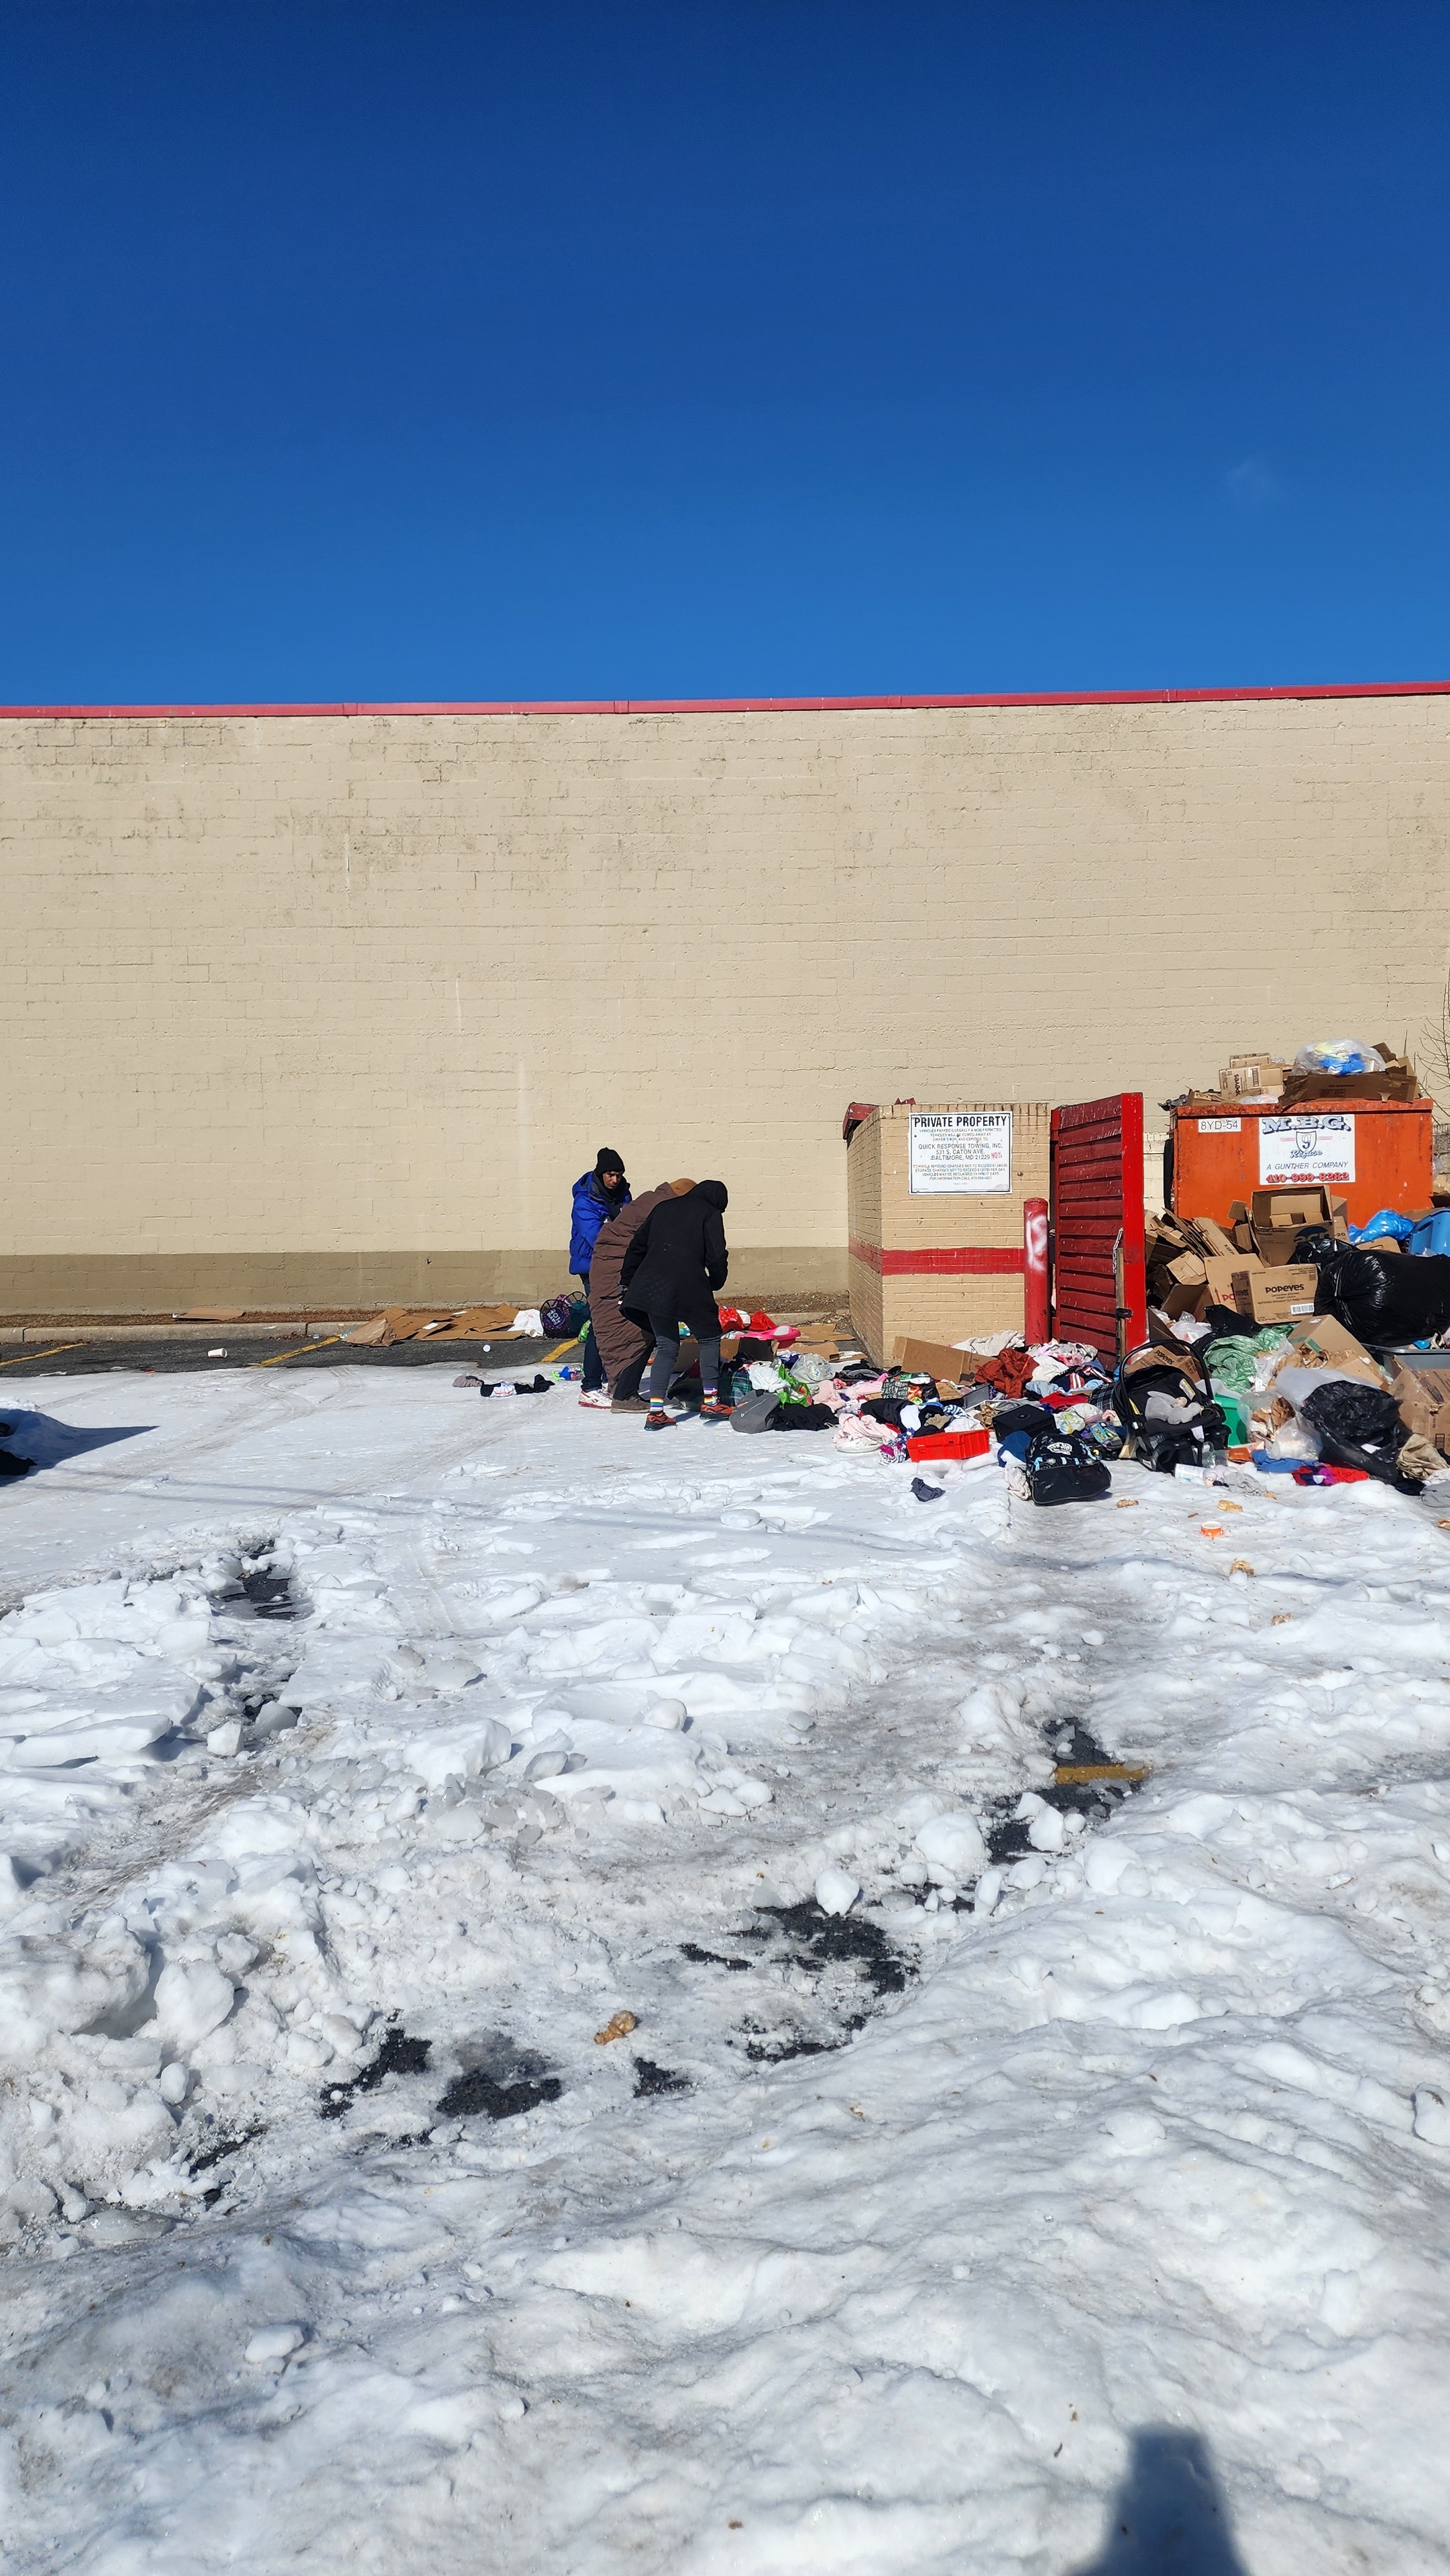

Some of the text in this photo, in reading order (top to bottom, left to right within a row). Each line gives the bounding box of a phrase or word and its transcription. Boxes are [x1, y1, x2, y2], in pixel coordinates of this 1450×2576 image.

[914, 1116, 1007, 1127] PRIVATE PROPERTY
[1201, 1121, 1239, 1130] 8YD-54
[1262, 1116, 1351, 1135] M.B.G.
[1290, 1149, 1323, 1159] Refuse
